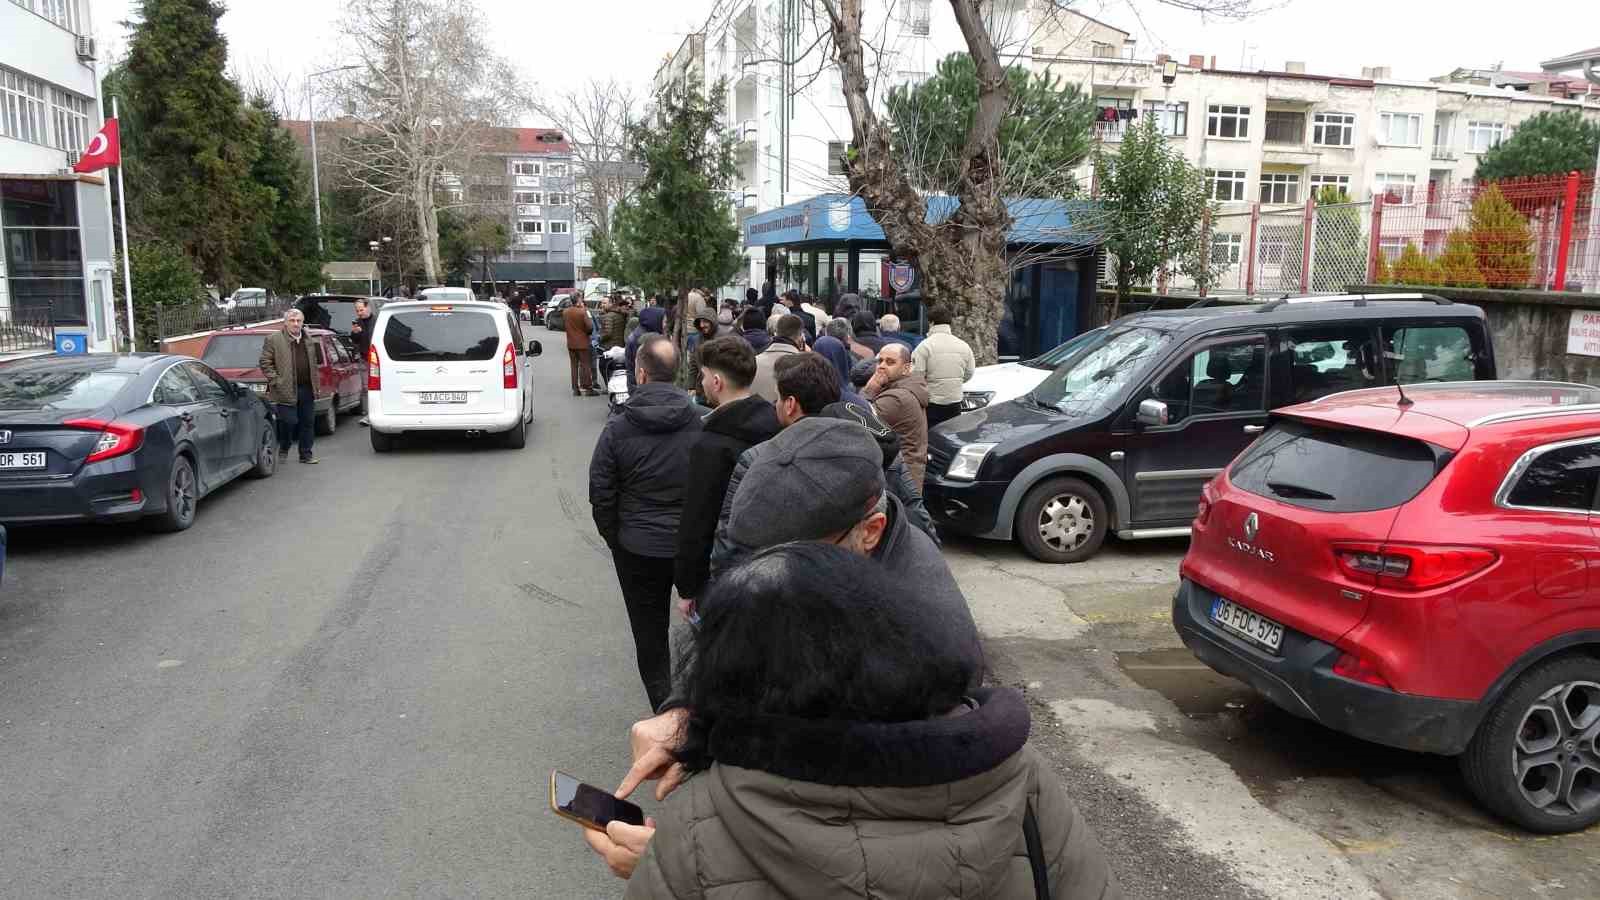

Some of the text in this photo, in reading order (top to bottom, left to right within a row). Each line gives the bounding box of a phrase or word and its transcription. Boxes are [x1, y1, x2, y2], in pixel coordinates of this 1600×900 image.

[23, 453, 42, 466] 561
[1217, 600, 1232, 620] 06
[1232, 607, 1256, 632] FDC
[1257, 619, 1281, 645] 575
